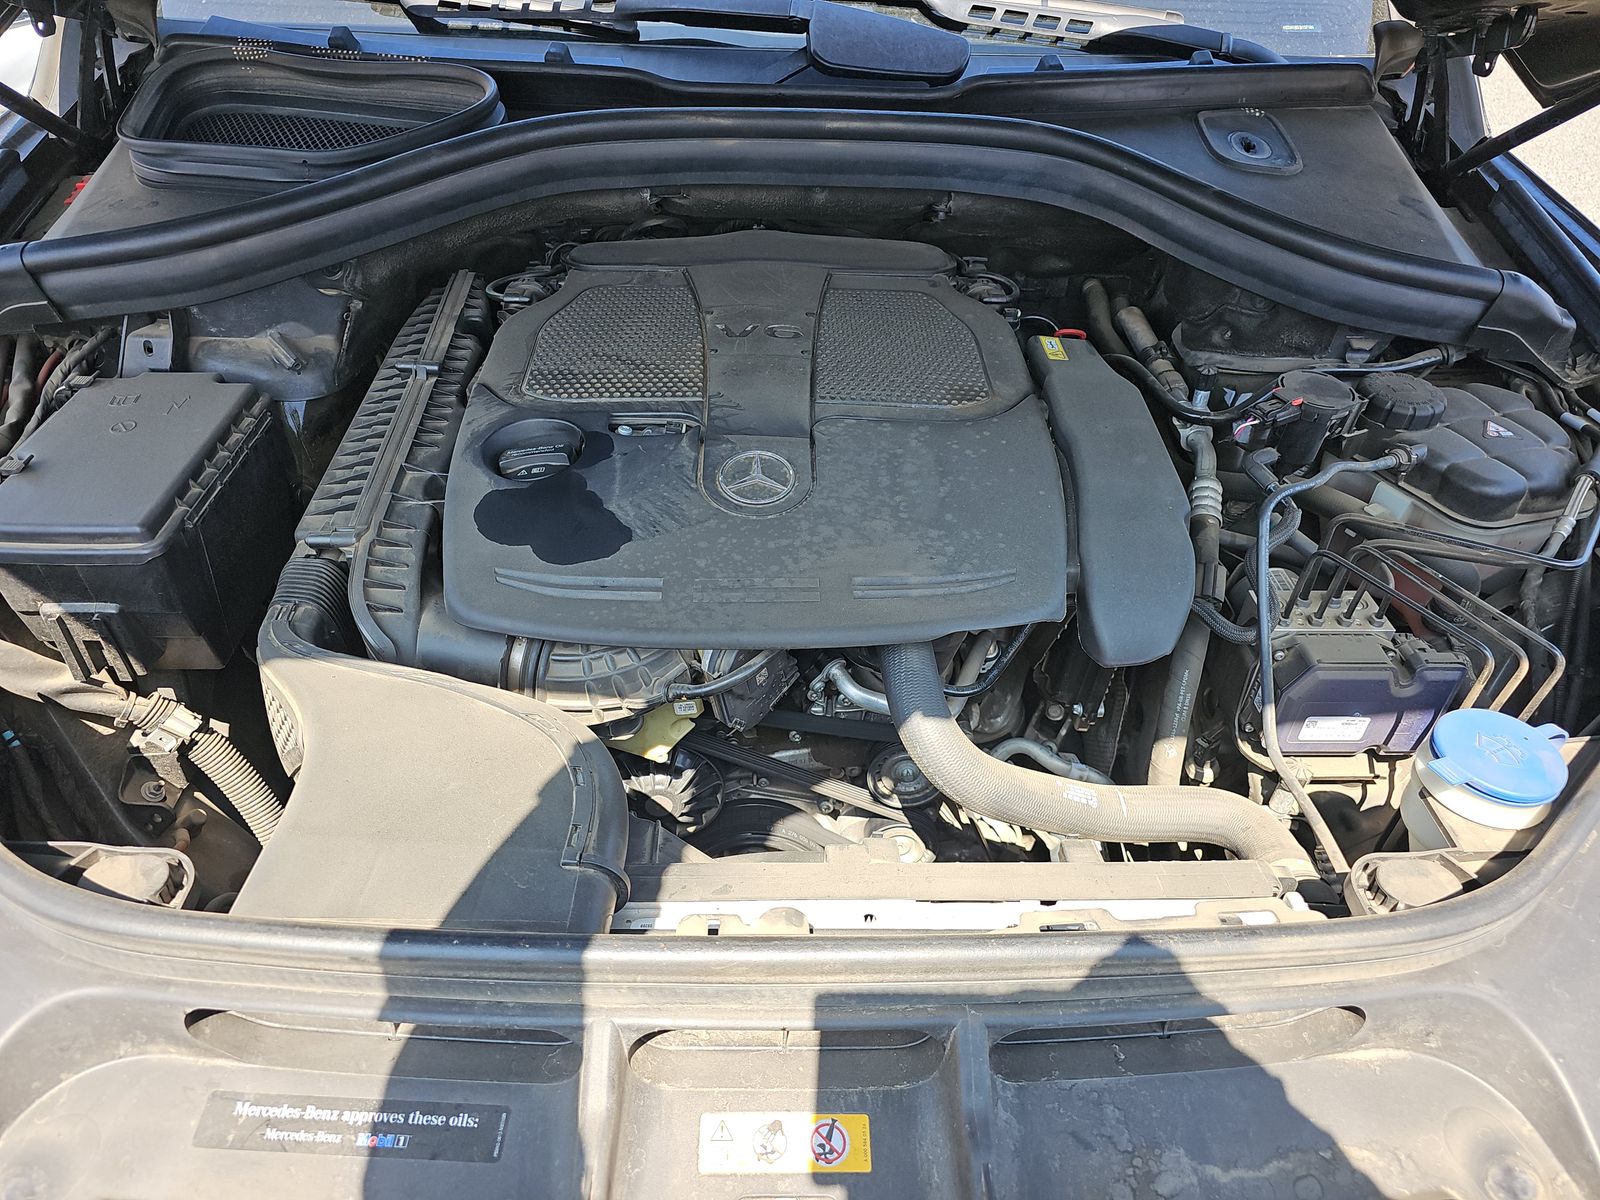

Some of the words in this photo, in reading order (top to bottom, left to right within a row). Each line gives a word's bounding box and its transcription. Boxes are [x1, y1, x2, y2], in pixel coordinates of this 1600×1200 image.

[715, 323, 804, 338] V6
[233, 1102, 339, 1120] Mercedes-Benz
[340, 1110, 404, 1126] approves
[407, 1110, 446, 1127] these
[449, 1113, 479, 1127] oils:
[264, 1128, 343, 1143] Mercedes-Benz
[356, 1133, 395, 1148] Mobil
